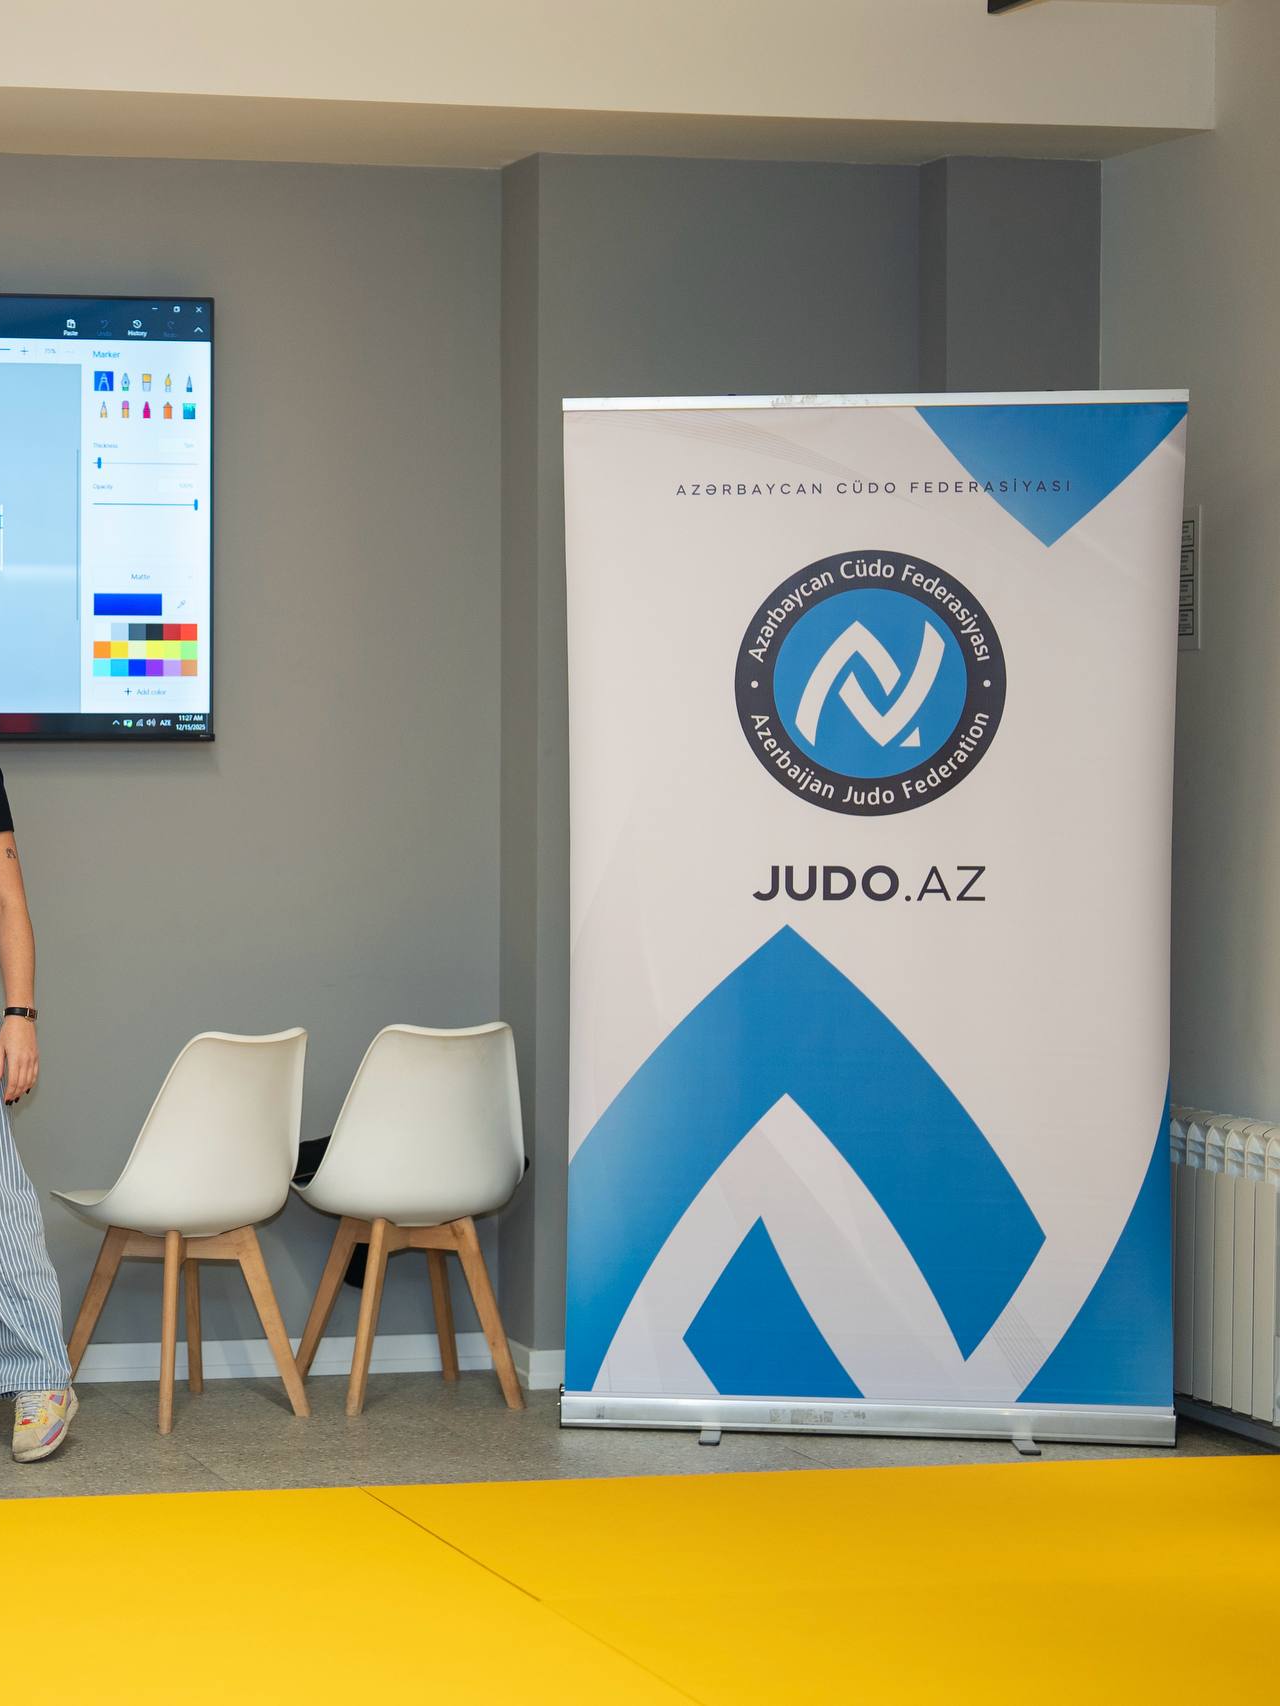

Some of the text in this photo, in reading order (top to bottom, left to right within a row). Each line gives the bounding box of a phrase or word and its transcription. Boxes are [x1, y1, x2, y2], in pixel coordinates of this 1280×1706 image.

[128, 330, 147, 338] History
[92, 350, 120, 359] Marker
[676, 478, 1072, 497] AZƏRBAYCAN CÜDO FEDERASİYASI
[748, 559, 990, 664] Azərbaycan Cüdo Federasiyası
[750, 712, 990, 806] Azerbaijan Judo Federation
[752, 865, 986, 902] JUDO.AZ
